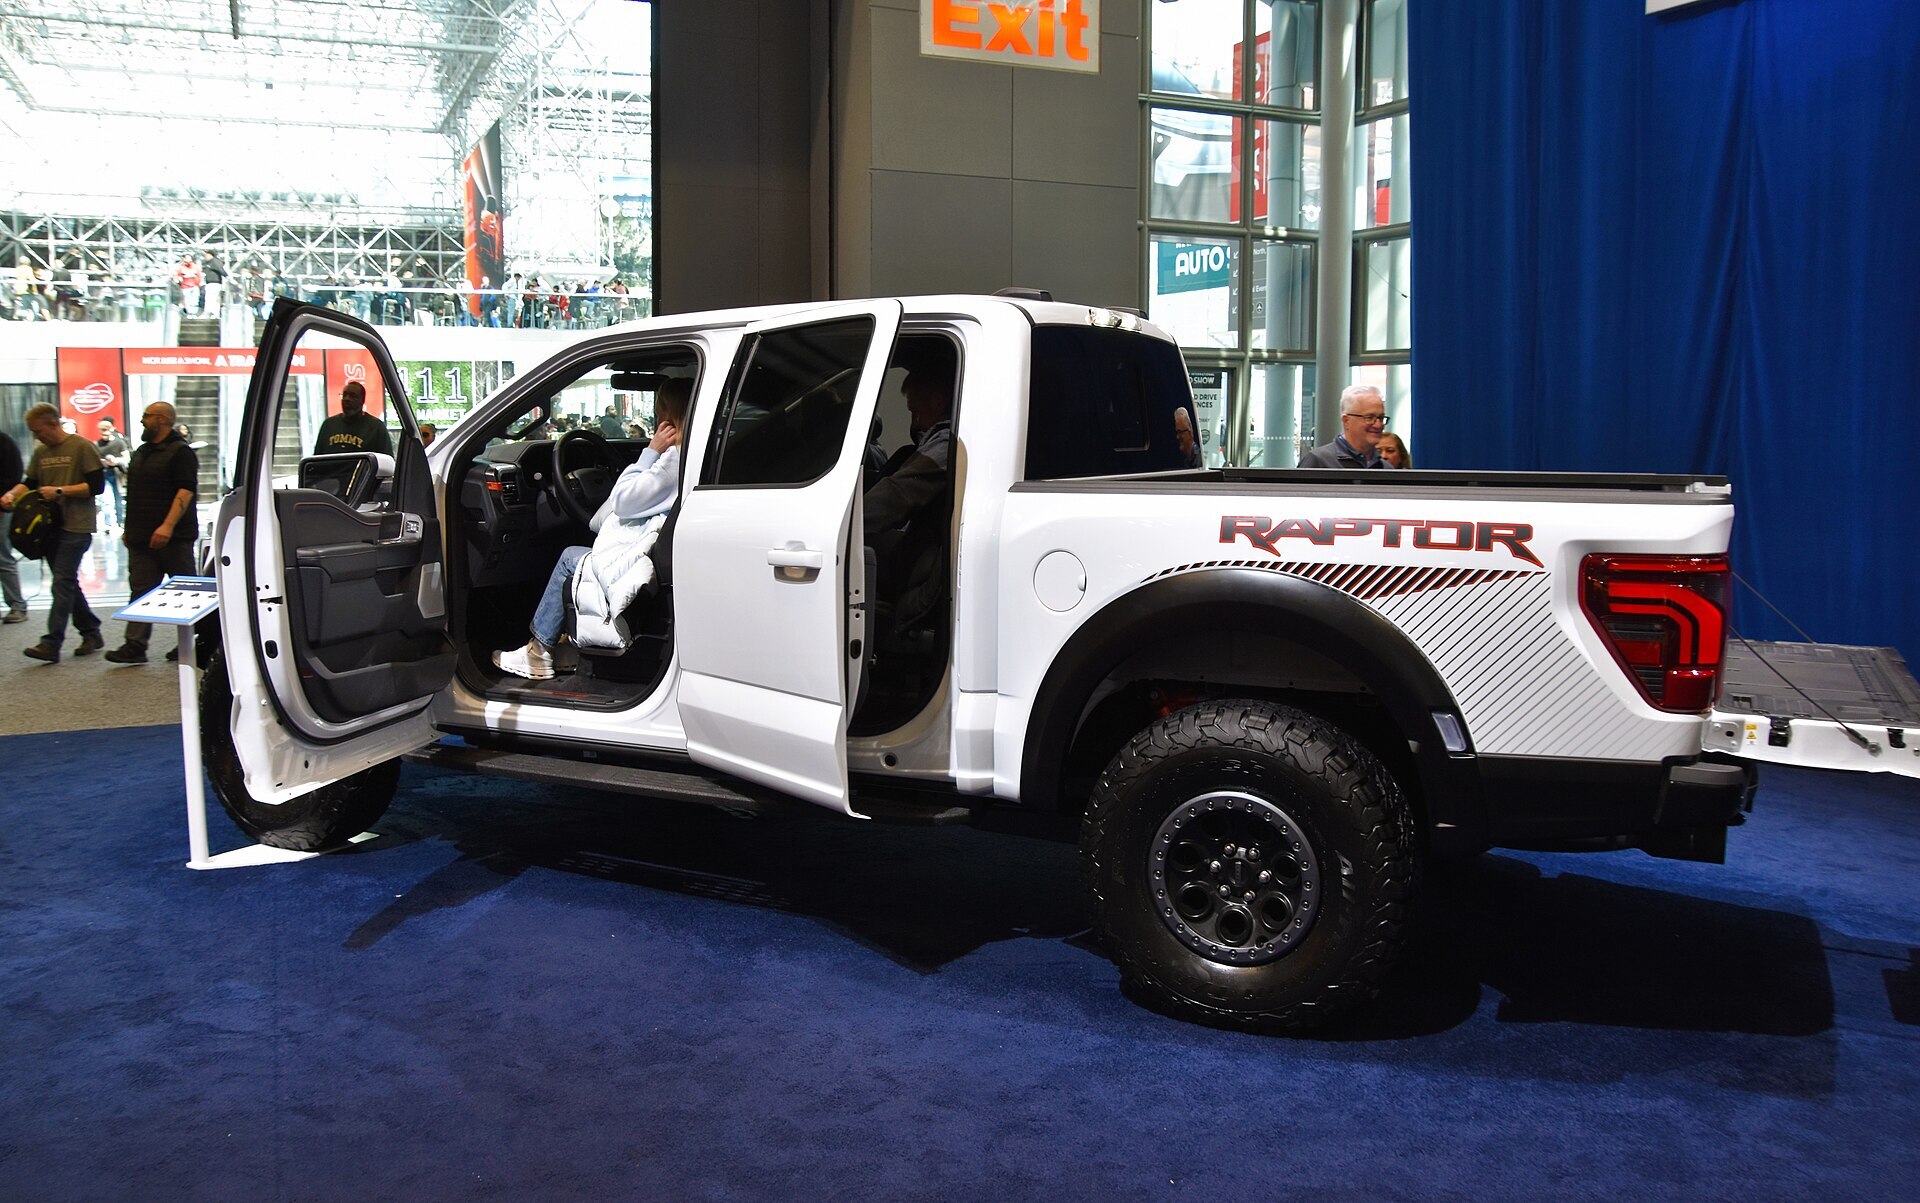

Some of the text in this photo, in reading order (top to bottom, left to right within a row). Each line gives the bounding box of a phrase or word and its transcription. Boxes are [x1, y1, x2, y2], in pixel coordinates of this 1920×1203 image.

[932, 0, 1089, 62] Exit
[1176, 246, 1225, 277] AUTO
[1193, 376, 1215, 385] SHOW
[1199, 393, 1218, 401] DRIVE
[329, 433, 363, 448] TOMMY
[1219, 515, 1544, 568] RAPTOR
